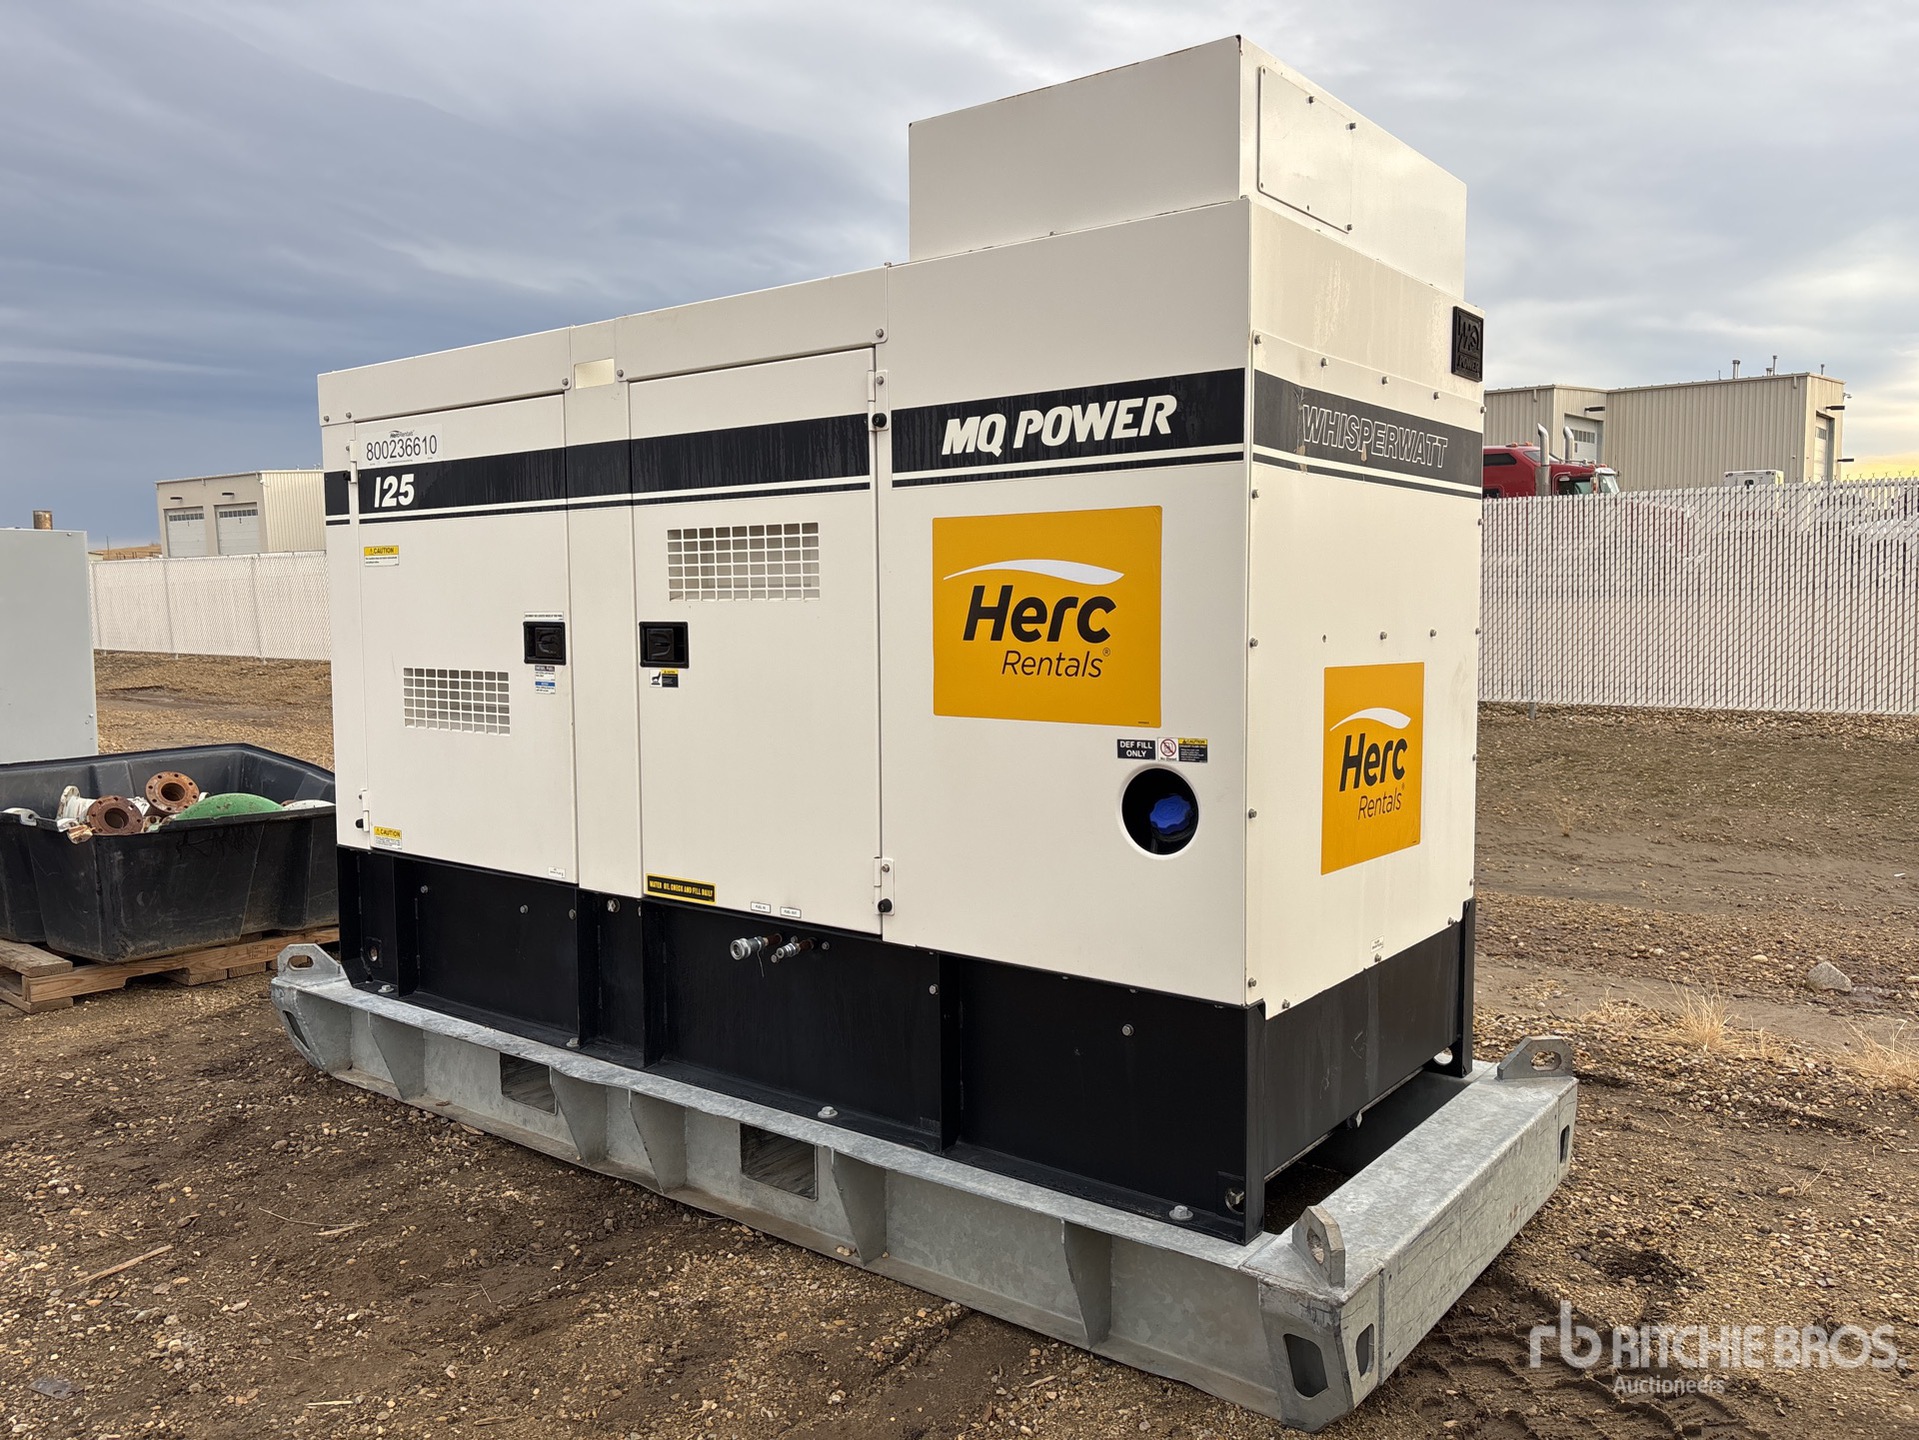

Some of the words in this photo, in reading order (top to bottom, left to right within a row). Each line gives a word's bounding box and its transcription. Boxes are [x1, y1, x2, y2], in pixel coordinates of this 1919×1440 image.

[941, 413, 1007, 457] MQ
[1013, 394, 1178, 449] POWER
[1302, 404, 1448, 468] WHISPERWATT
[366, 434, 438, 461] 800236610
[374, 473, 415, 508] 125
[373, 547, 394, 555] CAUTION
[962, 584, 1117, 644] Herc
[1126, 750, 1147, 758] ONLY
[1136, 741, 1153, 749] FILL
[1339, 732, 1408, 792] Herc
[380, 828, 401, 837] CAUTION
